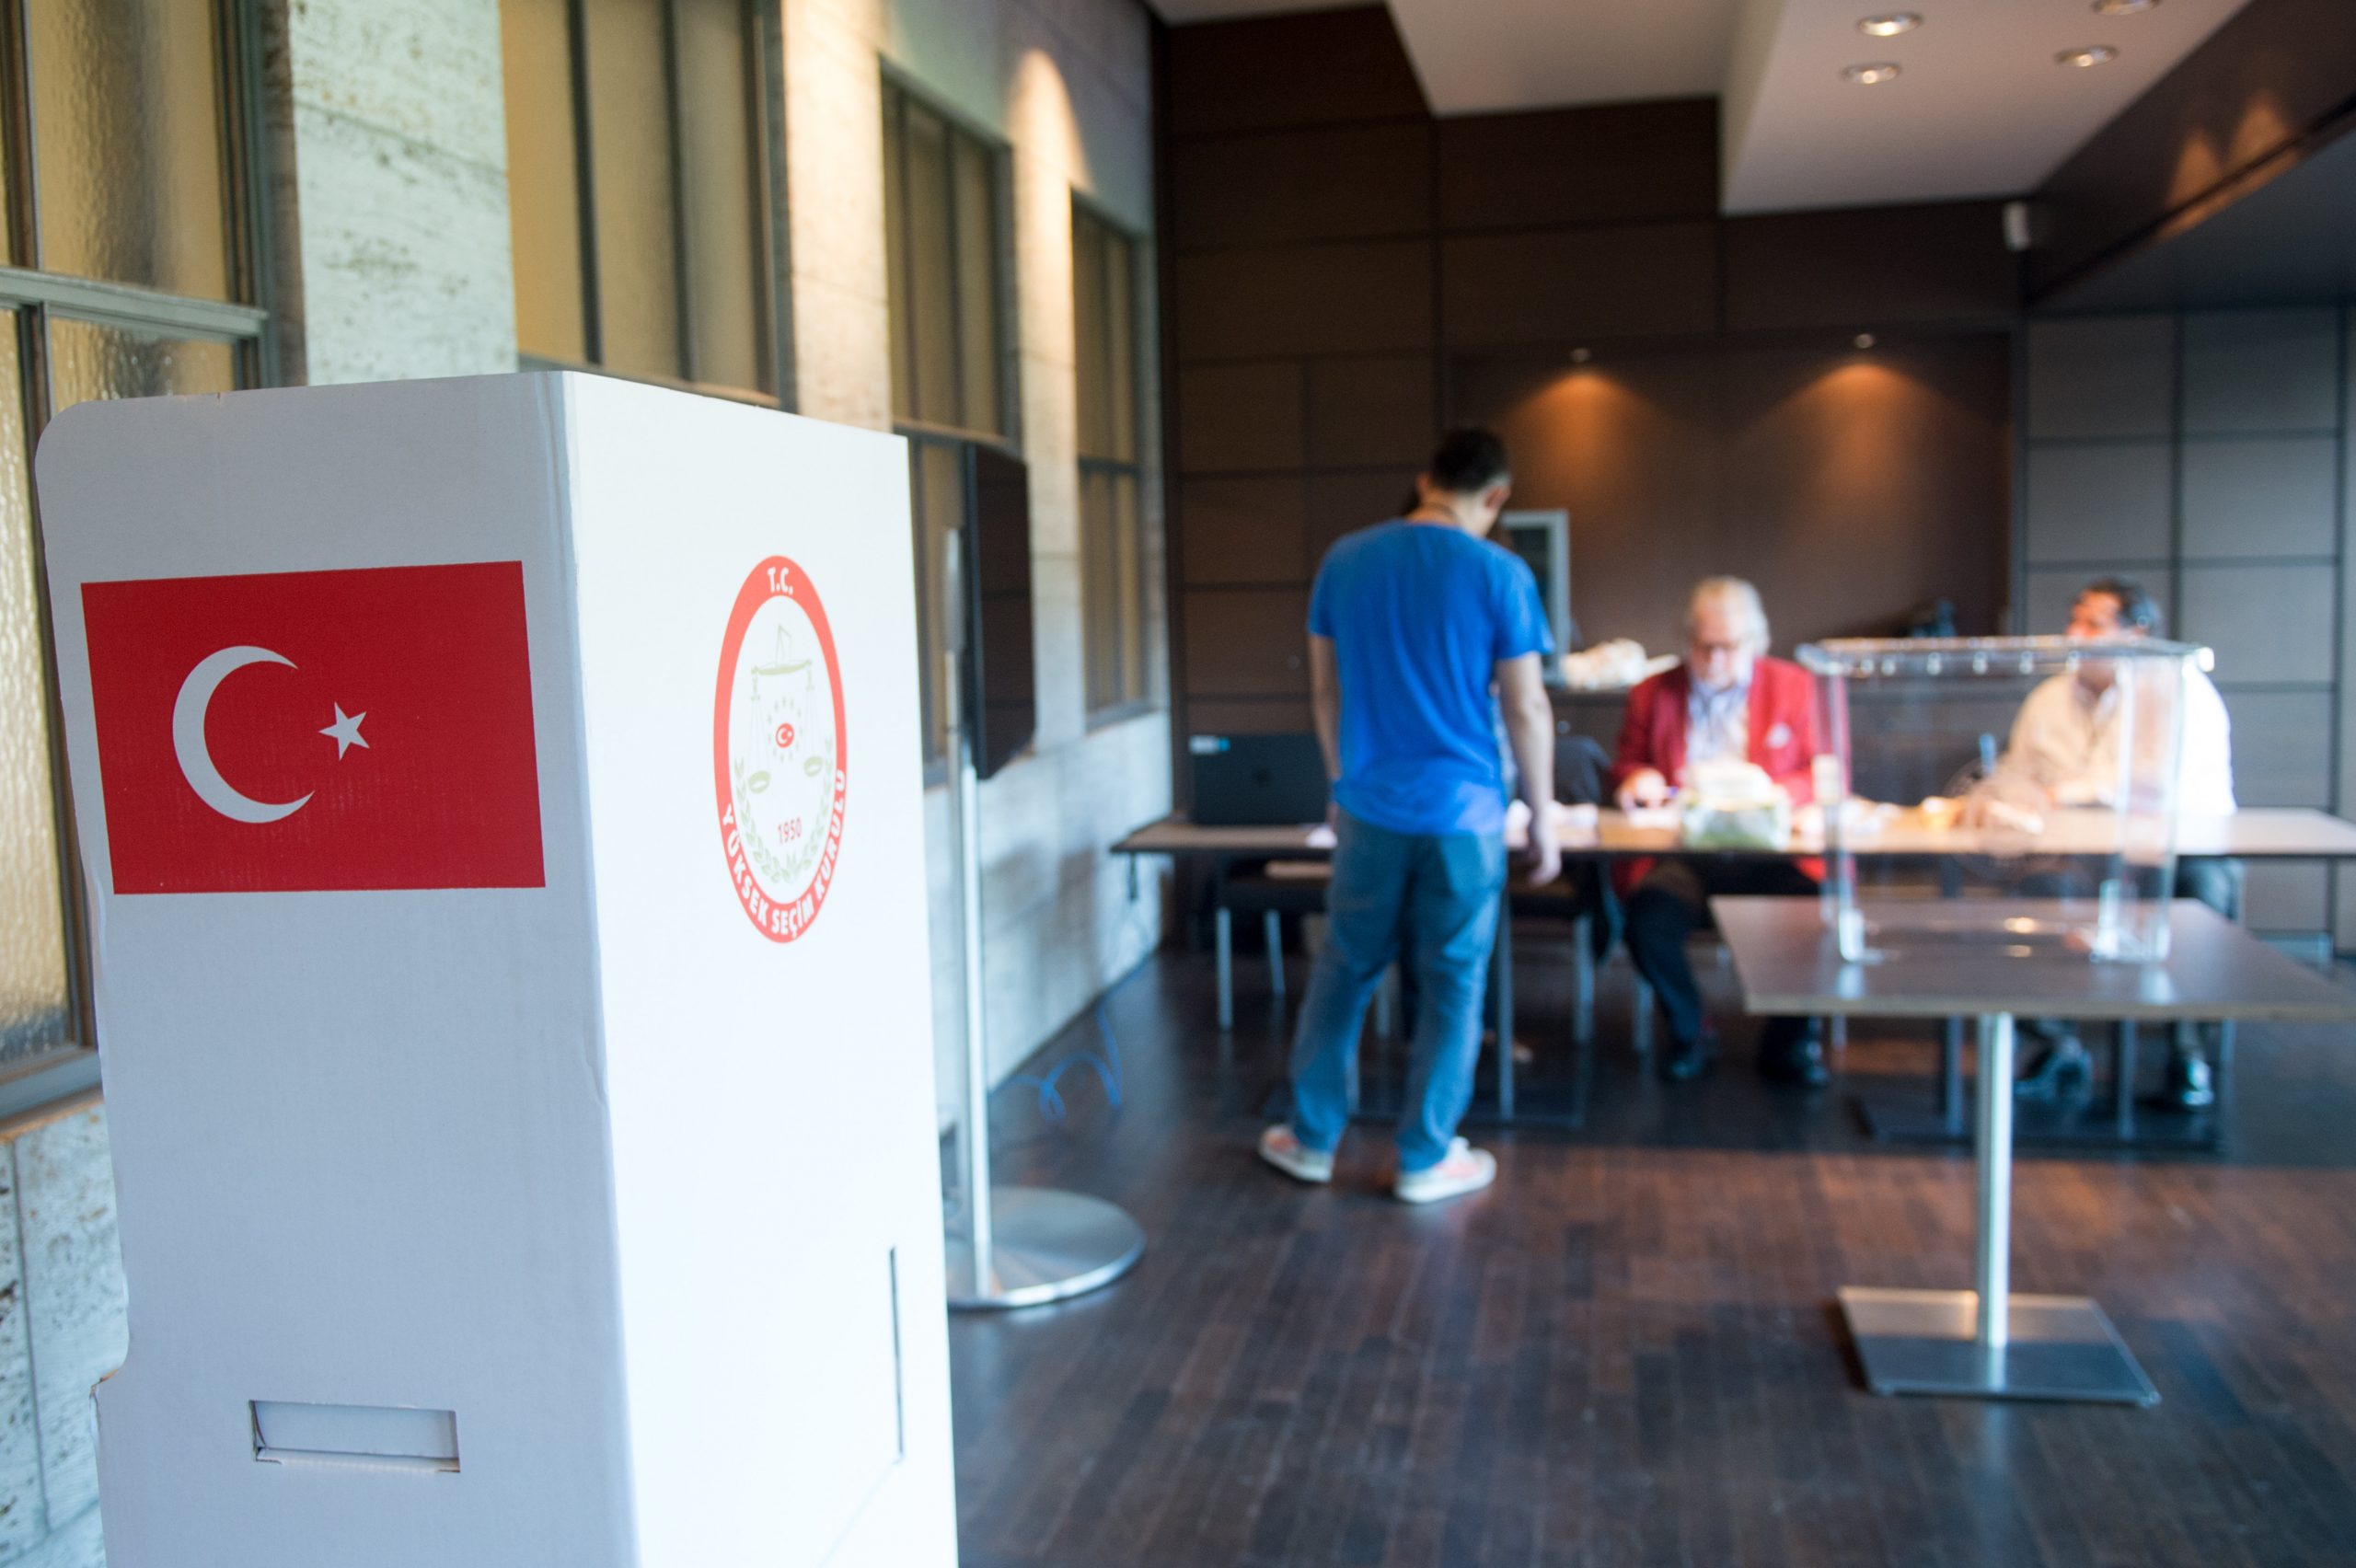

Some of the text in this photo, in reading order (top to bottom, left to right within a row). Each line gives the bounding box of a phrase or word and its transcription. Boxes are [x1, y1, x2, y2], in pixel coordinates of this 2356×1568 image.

[768, 566, 793, 595] T.C.
[778, 817, 802, 844] 1950
[722, 769, 847, 939] YÜKSEK SEÇİM KURULU
